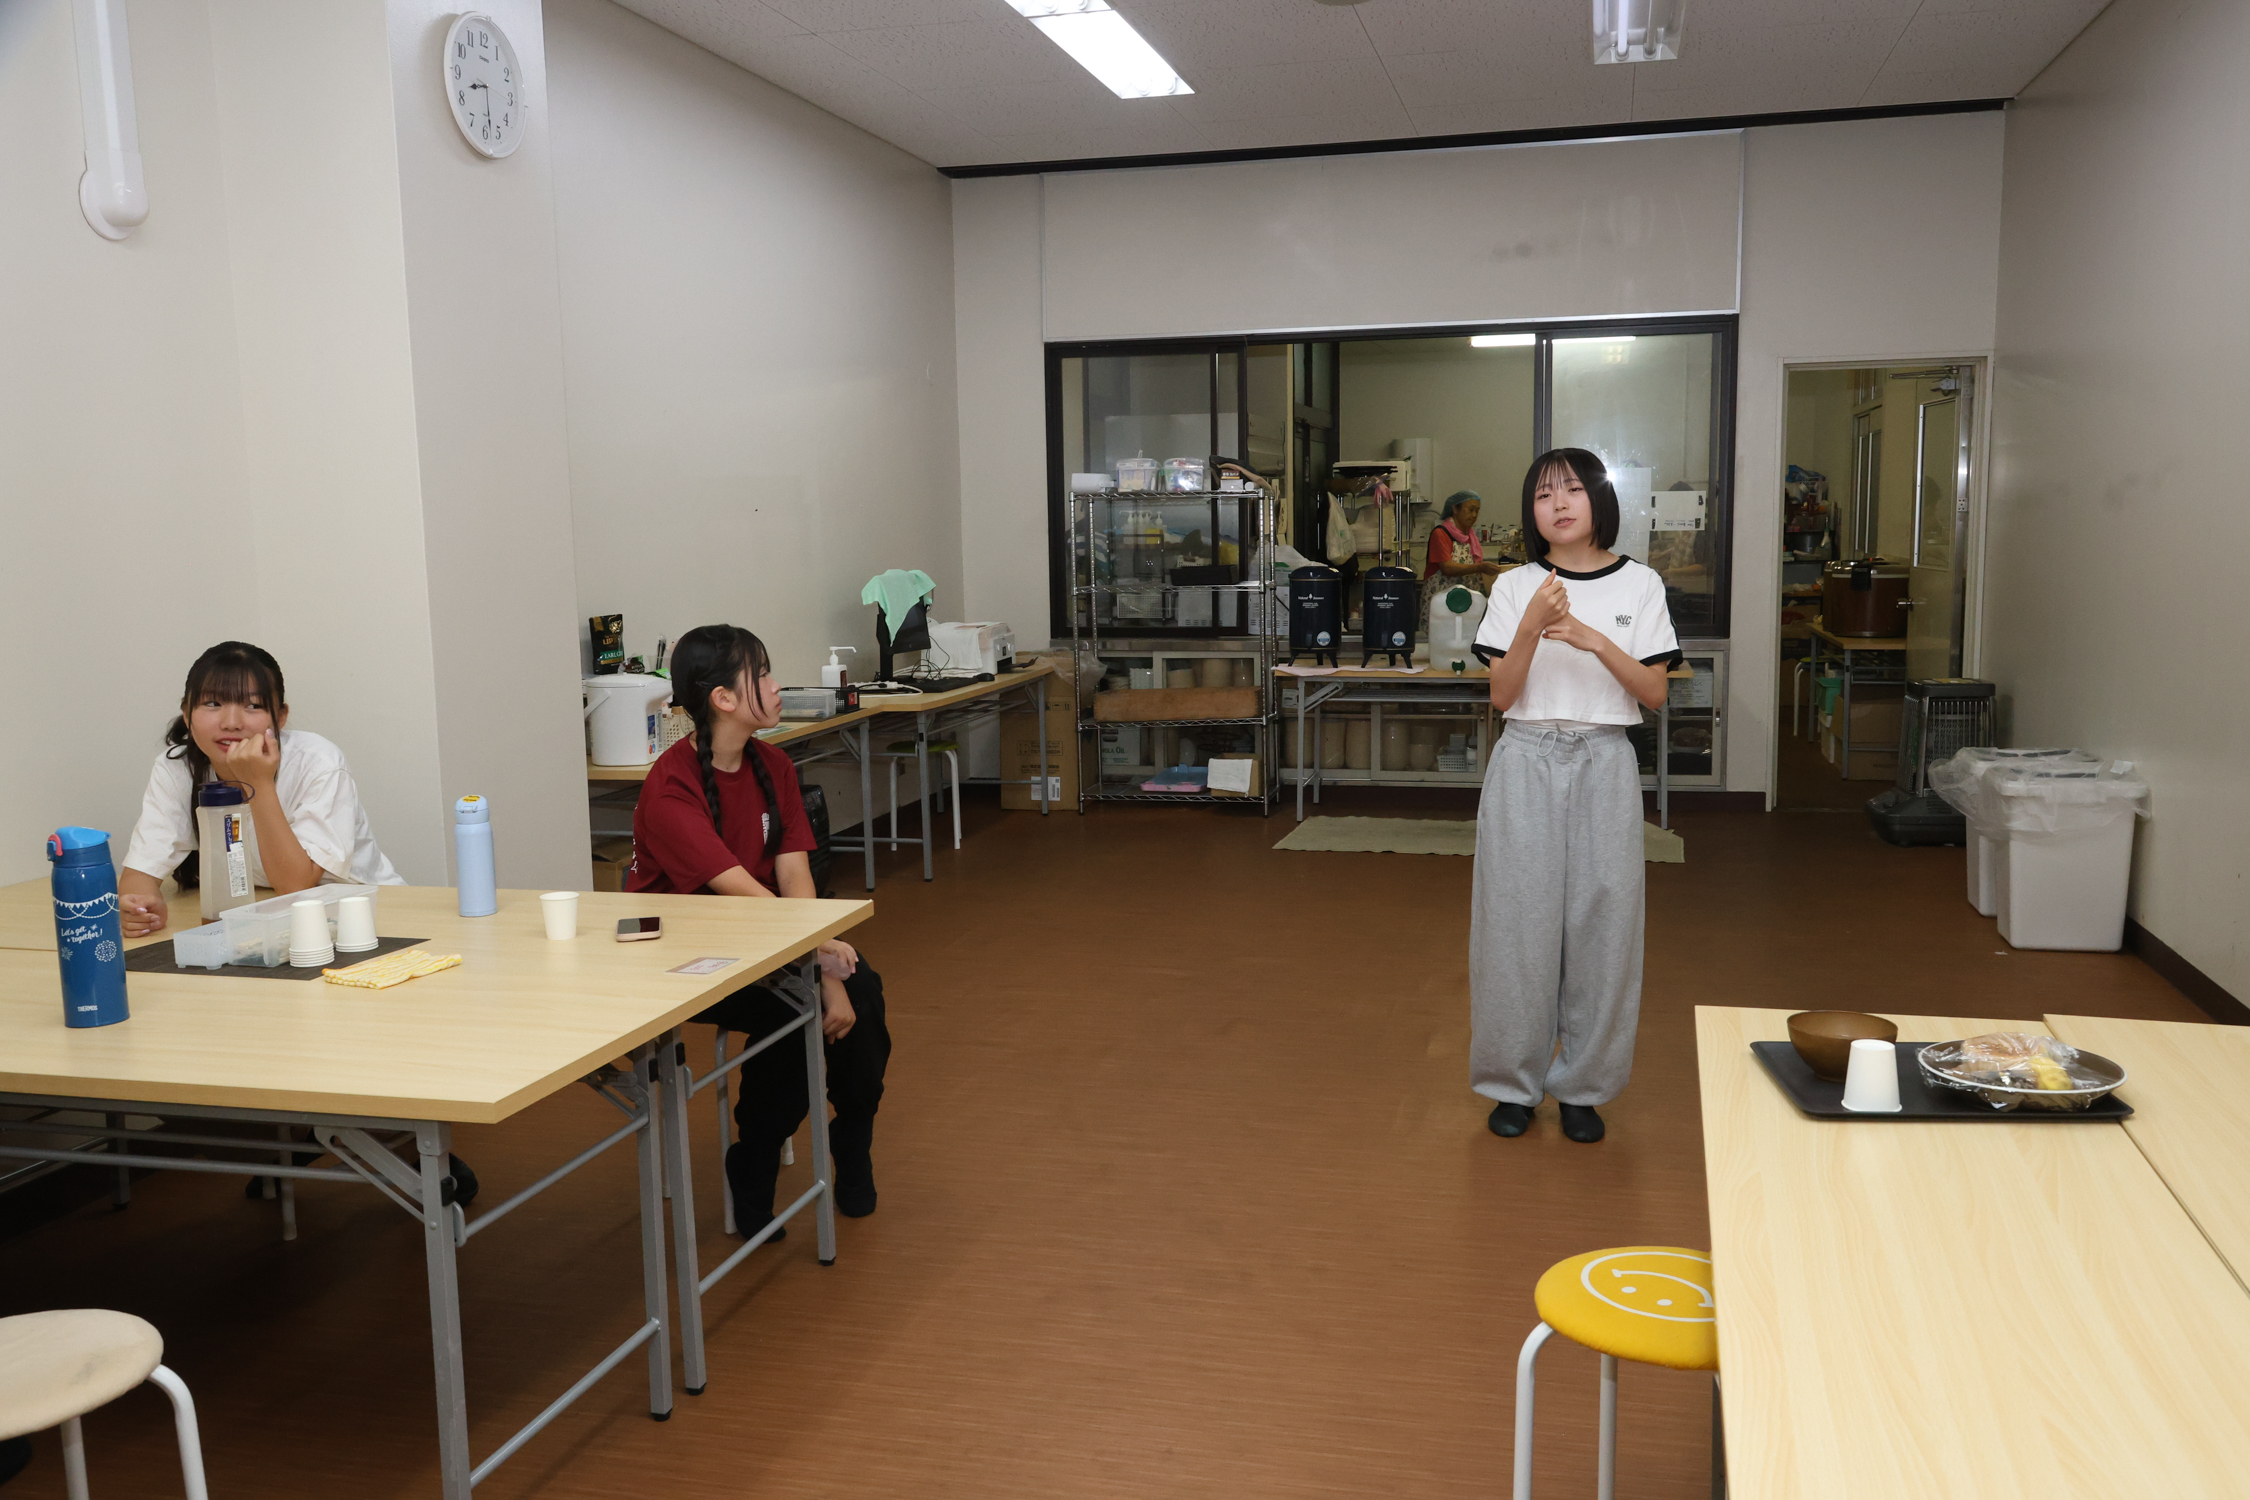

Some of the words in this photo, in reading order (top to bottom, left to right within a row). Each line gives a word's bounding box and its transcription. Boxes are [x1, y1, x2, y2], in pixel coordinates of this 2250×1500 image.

[466, 30, 475, 48] 11
[479, 30, 489, 49] 12
[457, 42, 467, 60] 10
[454, 64, 462, 80] 9
[503, 67, 510, 83] 2
[458, 89, 466, 106] 8
[507, 92, 513, 107] 3
[469, 112, 475, 128] 7
[503, 112, 509, 127] 4
[482, 124, 489, 141] 6
[495, 125, 501, 140] 5
[1615, 614, 1632, 625] NYC
[75, 925, 87, 937] get
